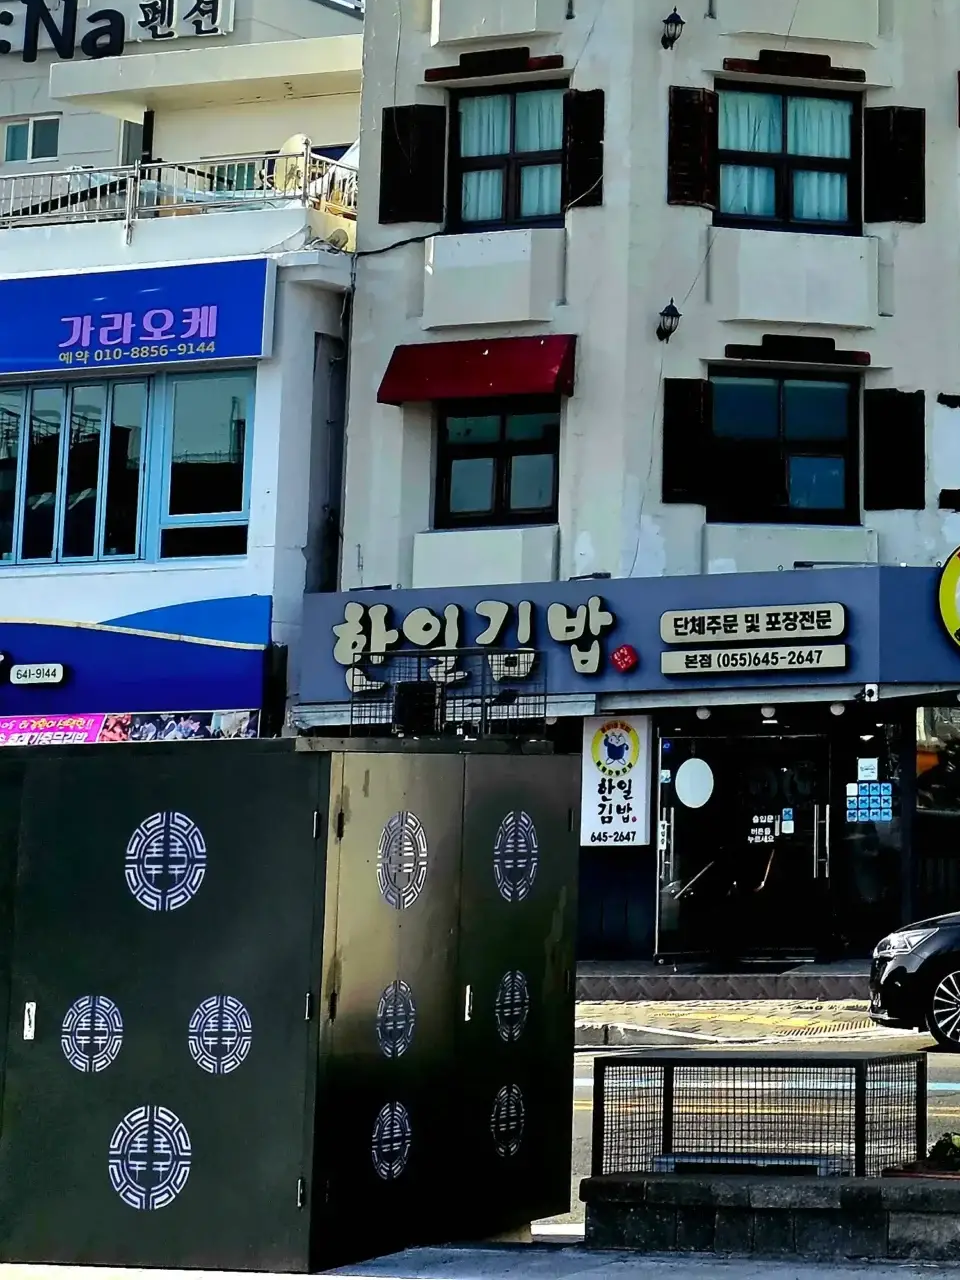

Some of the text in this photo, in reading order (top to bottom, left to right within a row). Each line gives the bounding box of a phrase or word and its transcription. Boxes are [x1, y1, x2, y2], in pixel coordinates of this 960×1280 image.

[58, 305, 218, 348] 가라오케
[58, 341, 216, 365] 예약 010-8856-9144
[673, 609, 832, 637] 단체주문 및 포장전문
[332, 595, 614, 693] 한일김밥
[684, 649, 823, 669] 본점 (055)645-2647
[16, 667, 57, 680] 641-9144
[597, 777, 633, 802] 한일
[597, 803, 633, 824] 김밥
[590, 831, 637, 842] 645-2647
